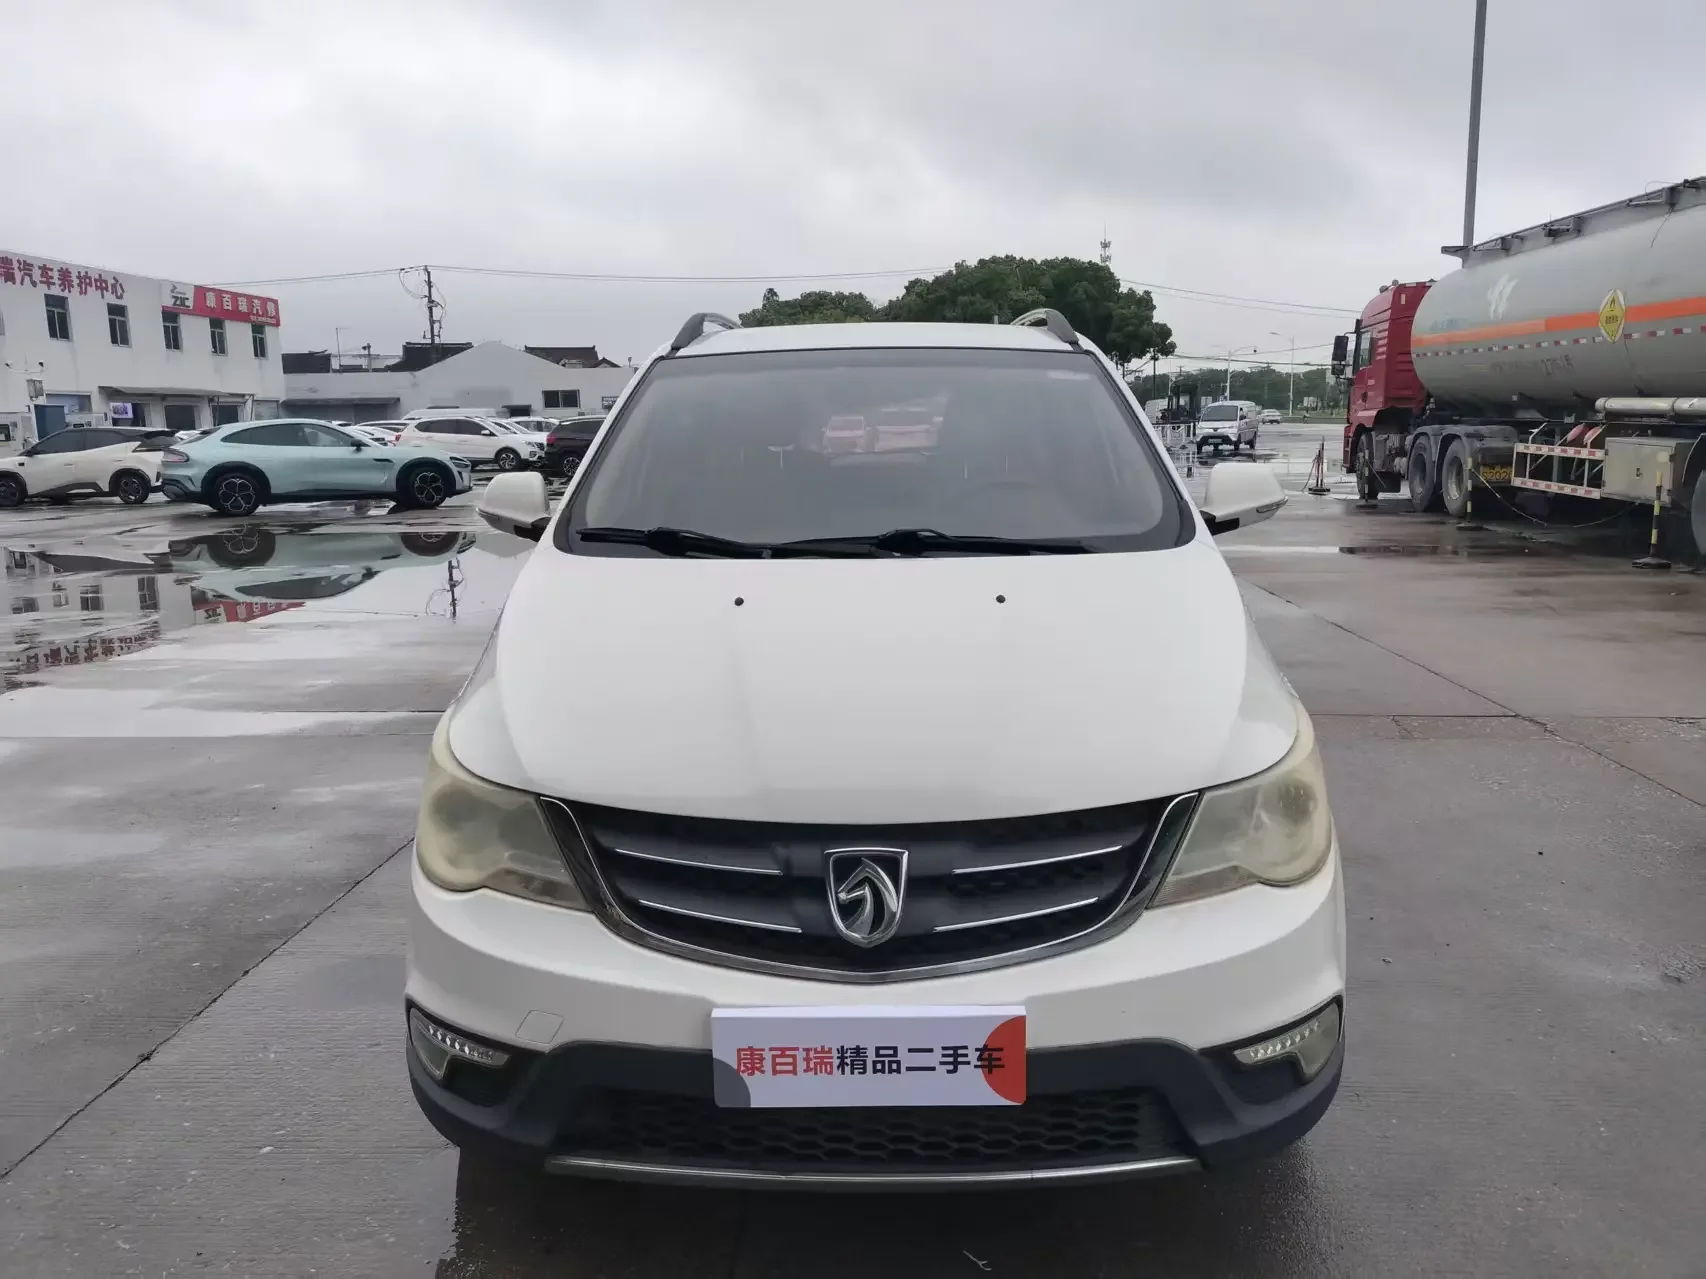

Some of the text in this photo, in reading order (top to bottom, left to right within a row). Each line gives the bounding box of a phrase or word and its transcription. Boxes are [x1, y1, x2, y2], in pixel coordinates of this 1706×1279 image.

[171, 295, 191, 308] ZIC
[736, 1044, 1005, 1076] 康百瑞精品二手车
